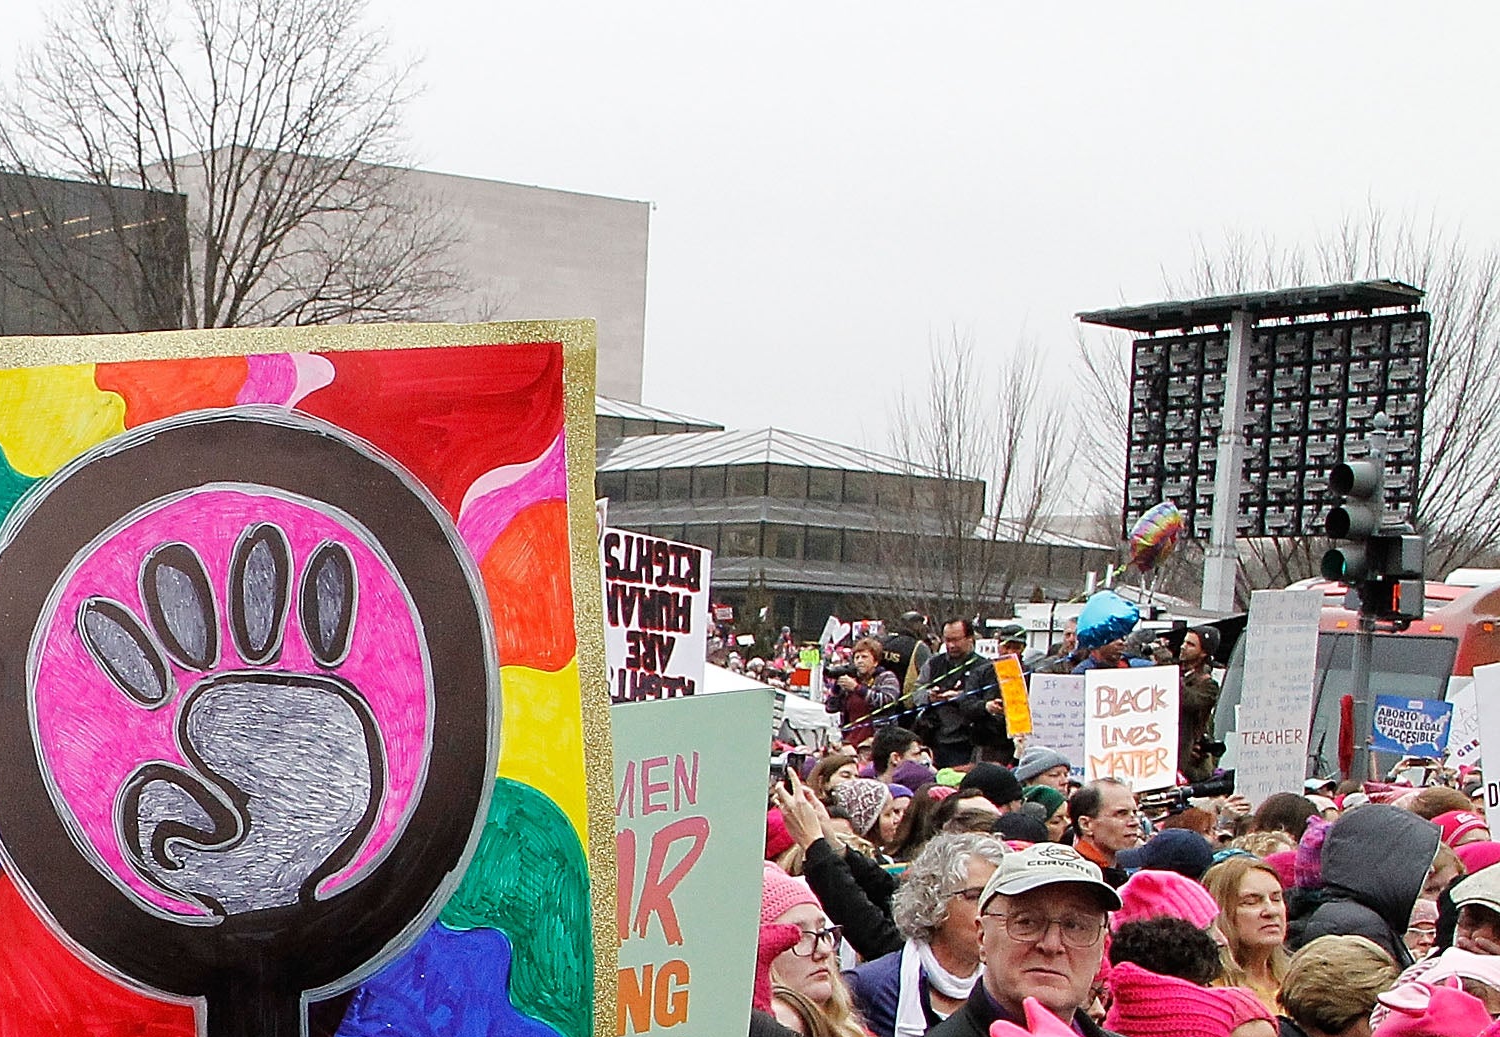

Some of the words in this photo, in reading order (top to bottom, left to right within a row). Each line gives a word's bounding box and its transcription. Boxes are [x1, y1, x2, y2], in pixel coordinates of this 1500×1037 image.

[604, 532, 702, 593] RIGHTS
[625, 630, 677, 675] ARE
[1092, 684, 1170, 719] BLACK
[1378, 707, 1418, 721] ABORTO
[1415, 722, 1442, 733] LEGAL
[1241, 728, 1304, 745] TEACHER
[1387, 729, 1437, 744] ACCESIBLE
[1088, 747, 1171, 780] MATTER
[1027, 860, 1094, 877] CORVETTE
